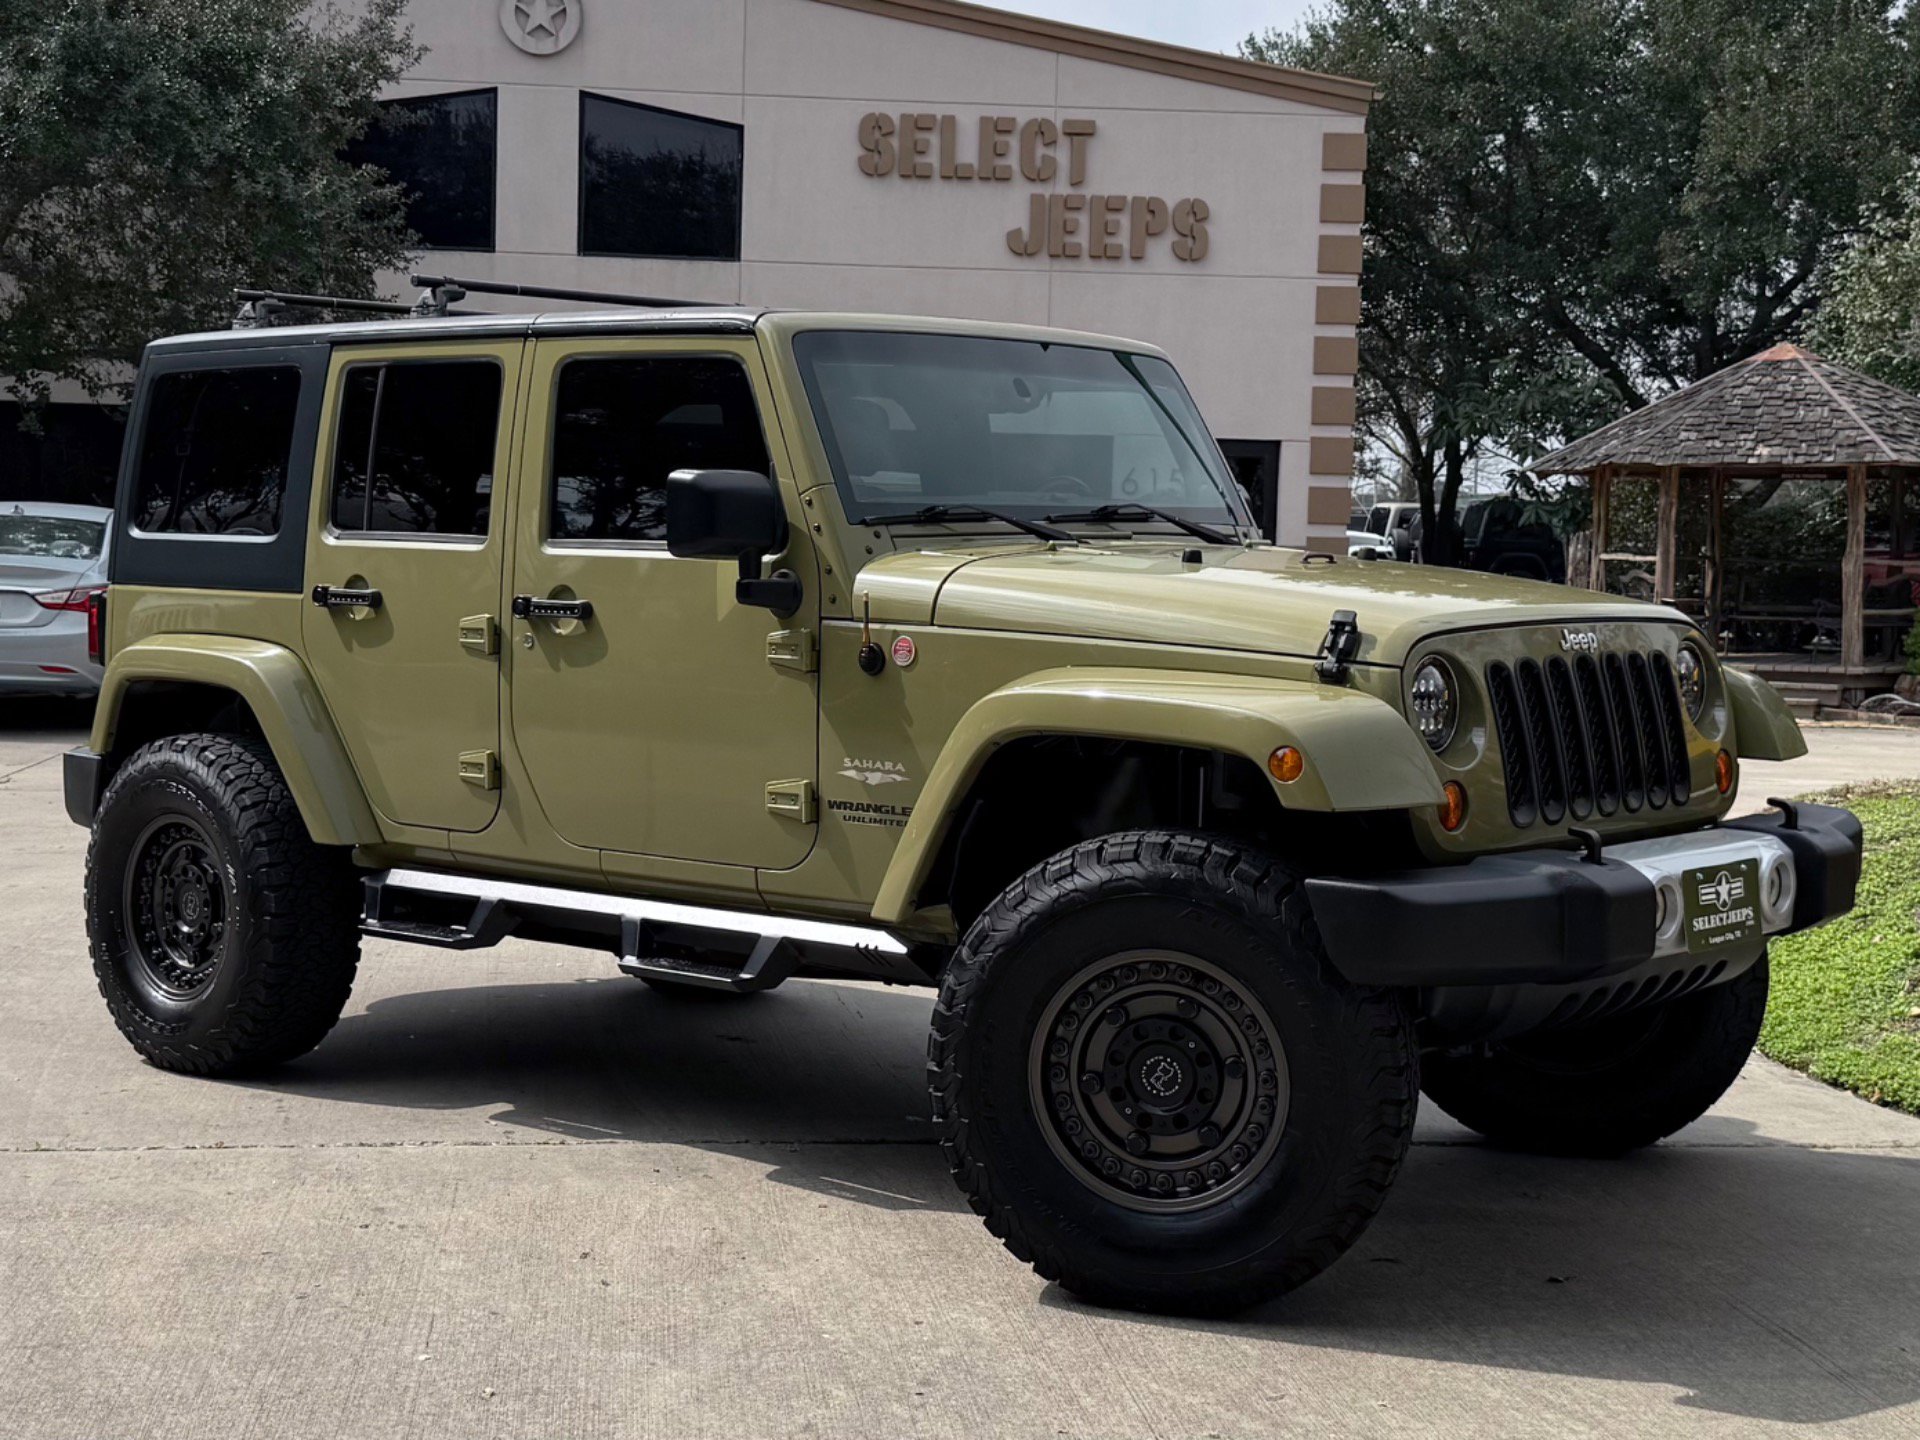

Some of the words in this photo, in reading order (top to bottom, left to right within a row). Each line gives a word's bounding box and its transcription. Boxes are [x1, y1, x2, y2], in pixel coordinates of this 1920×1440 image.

[857, 112, 1097, 186] SELECT
[1006, 193, 1210, 262] JEEPS
[1122, 466, 1185, 496] 615
[1560, 628, 1598, 653] Jeep
[843, 757, 906, 772] SAHARA
[827, 799, 914, 817] WRANGLE
[843, 814, 909, 827] UNLIMITE
